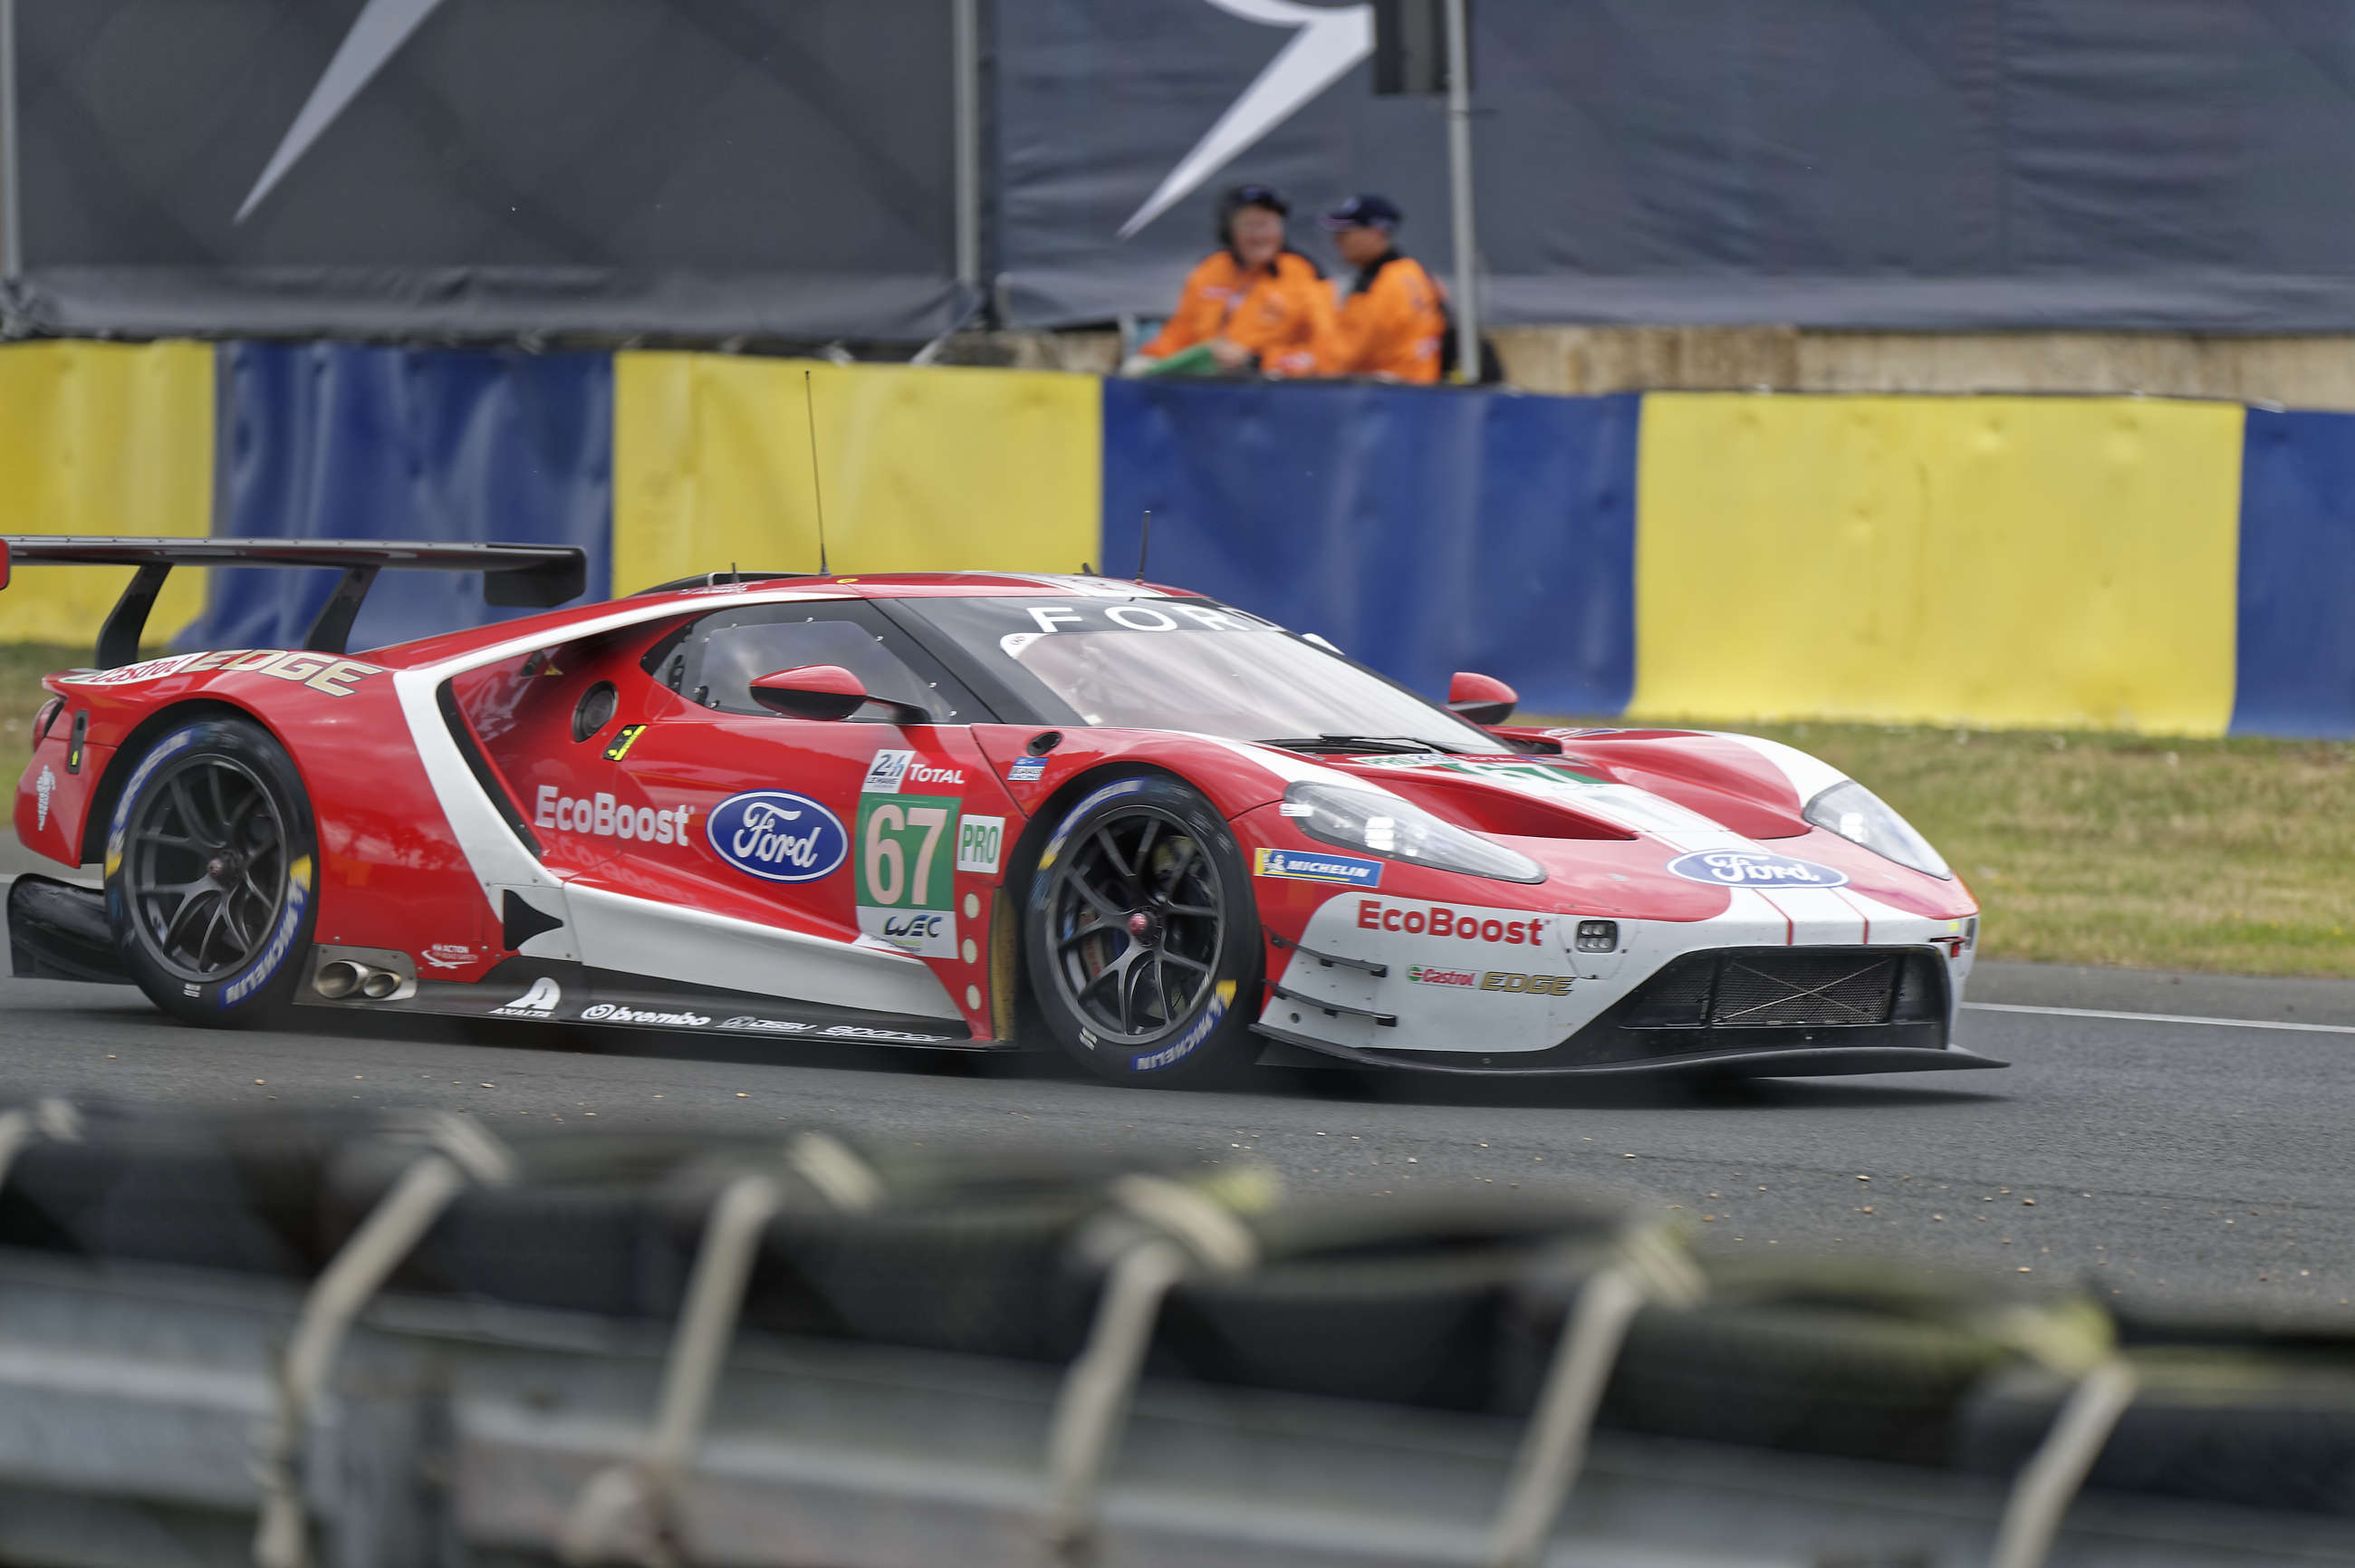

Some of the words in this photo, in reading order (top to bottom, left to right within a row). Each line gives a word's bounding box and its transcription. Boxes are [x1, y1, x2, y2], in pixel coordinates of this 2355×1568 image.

[180, 649, 384, 697] EDGE
[909, 763, 966, 784] TOTAL
[534, 784, 689, 846] EcoBoost
[733, 802, 822, 868] Ford
[962, 822, 999, 864] PRO
[864, 803, 948, 906] 67
[1286, 860, 1370, 878] MICHELIN
[1703, 853, 1820, 882] Ford
[884, 914, 943, 938] WEC
[1357, 899, 1545, 947] EcoBoost
[1422, 968, 1477, 987] Castrol
[1480, 971, 1577, 996] EDGE
[487, 1006, 556, 1018] AXALTA
[605, 1005, 712, 1026] brembo
